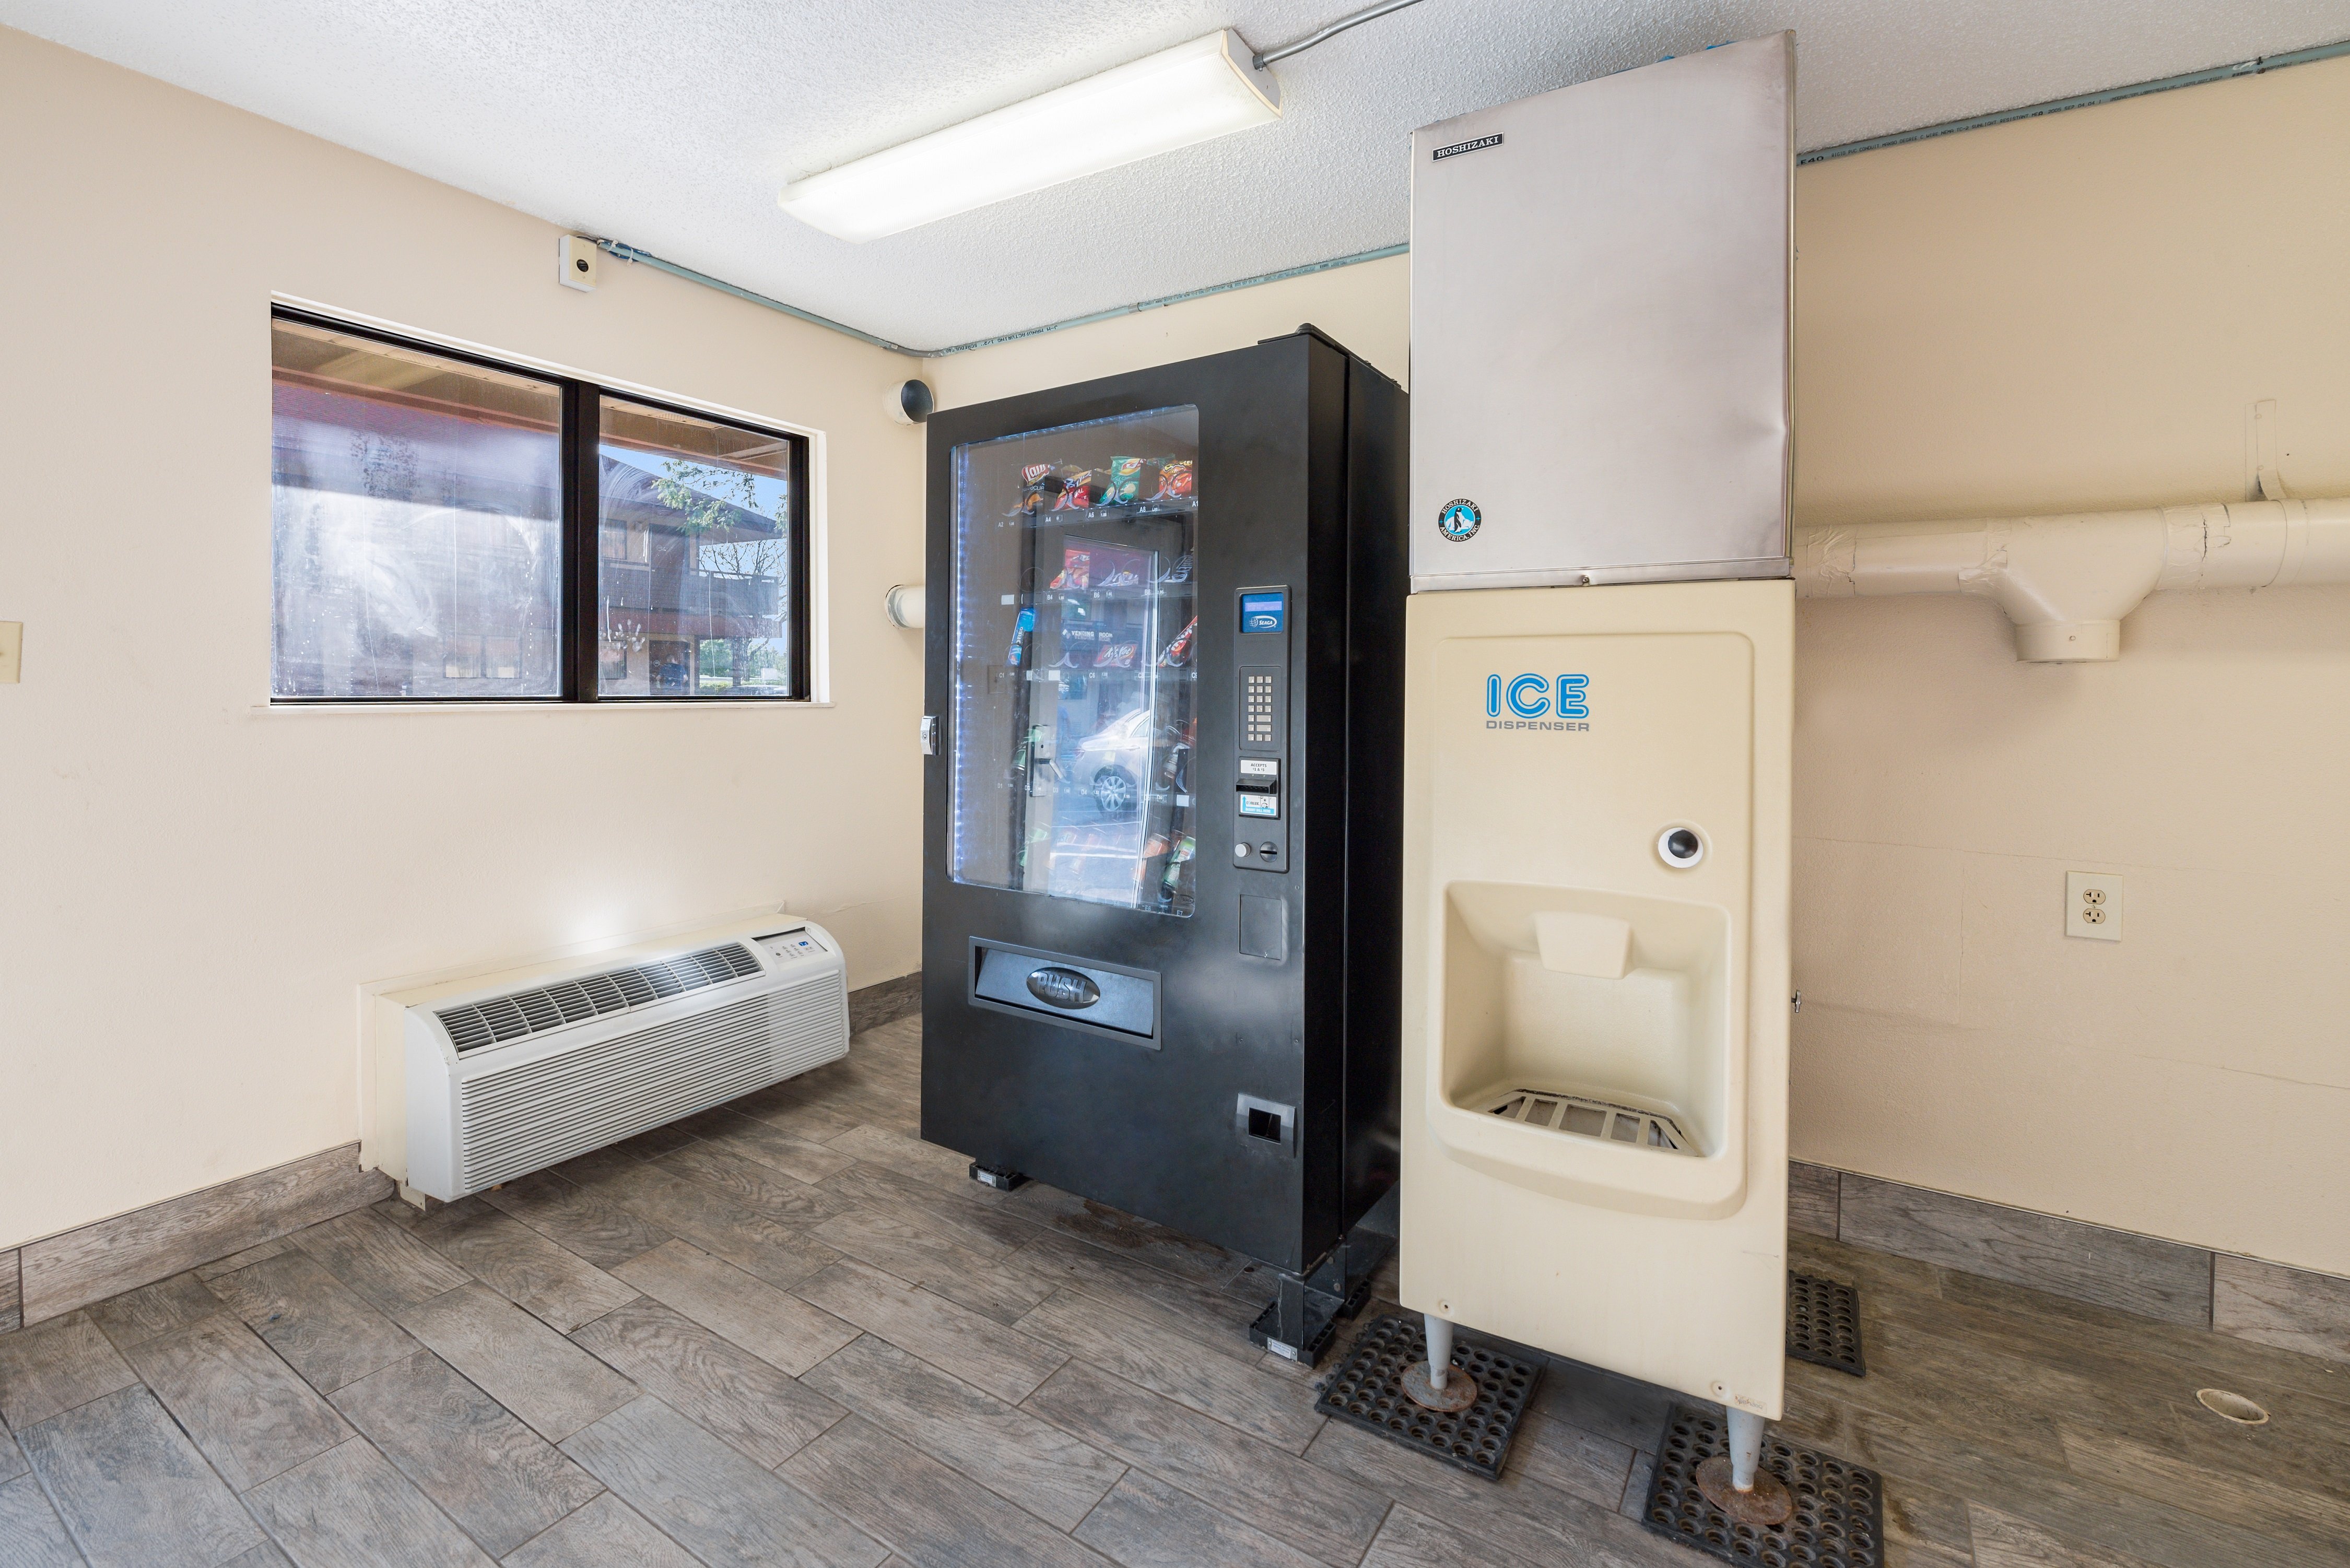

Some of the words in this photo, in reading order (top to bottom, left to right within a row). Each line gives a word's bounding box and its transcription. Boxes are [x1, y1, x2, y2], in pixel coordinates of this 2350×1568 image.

[1437, 136, 1499, 157] HOSHIZAKI
[997, 328, 1043, 343] MANUFACTURING
[1441, 499, 1478, 514] HOSHIZAKI
[1487, 673, 1589, 719] ICE
[1486, 721, 1589, 731] DISPENSER
[1037, 971, 1088, 1003] PUSH
